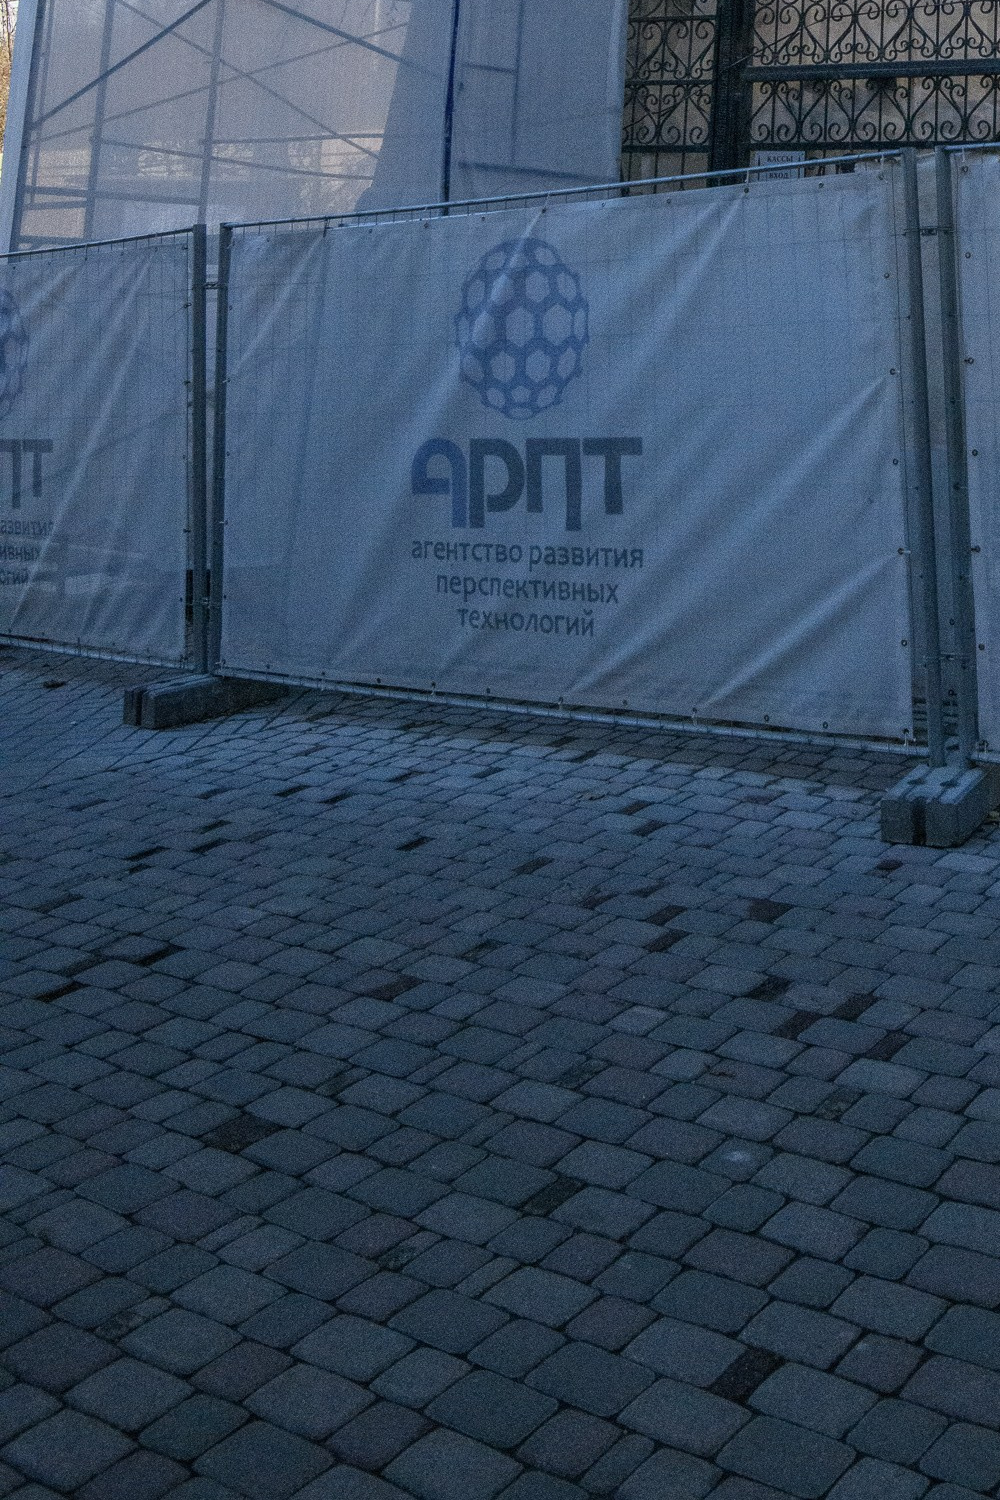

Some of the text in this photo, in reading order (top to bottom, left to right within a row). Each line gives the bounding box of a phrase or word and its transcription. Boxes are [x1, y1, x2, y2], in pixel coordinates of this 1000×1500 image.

[410, 436, 643, 531] АРПТ
[411, 539, 644, 572] агентство развития
[436, 574, 619, 604] перспективных
[456, 608, 594, 637] технологий
